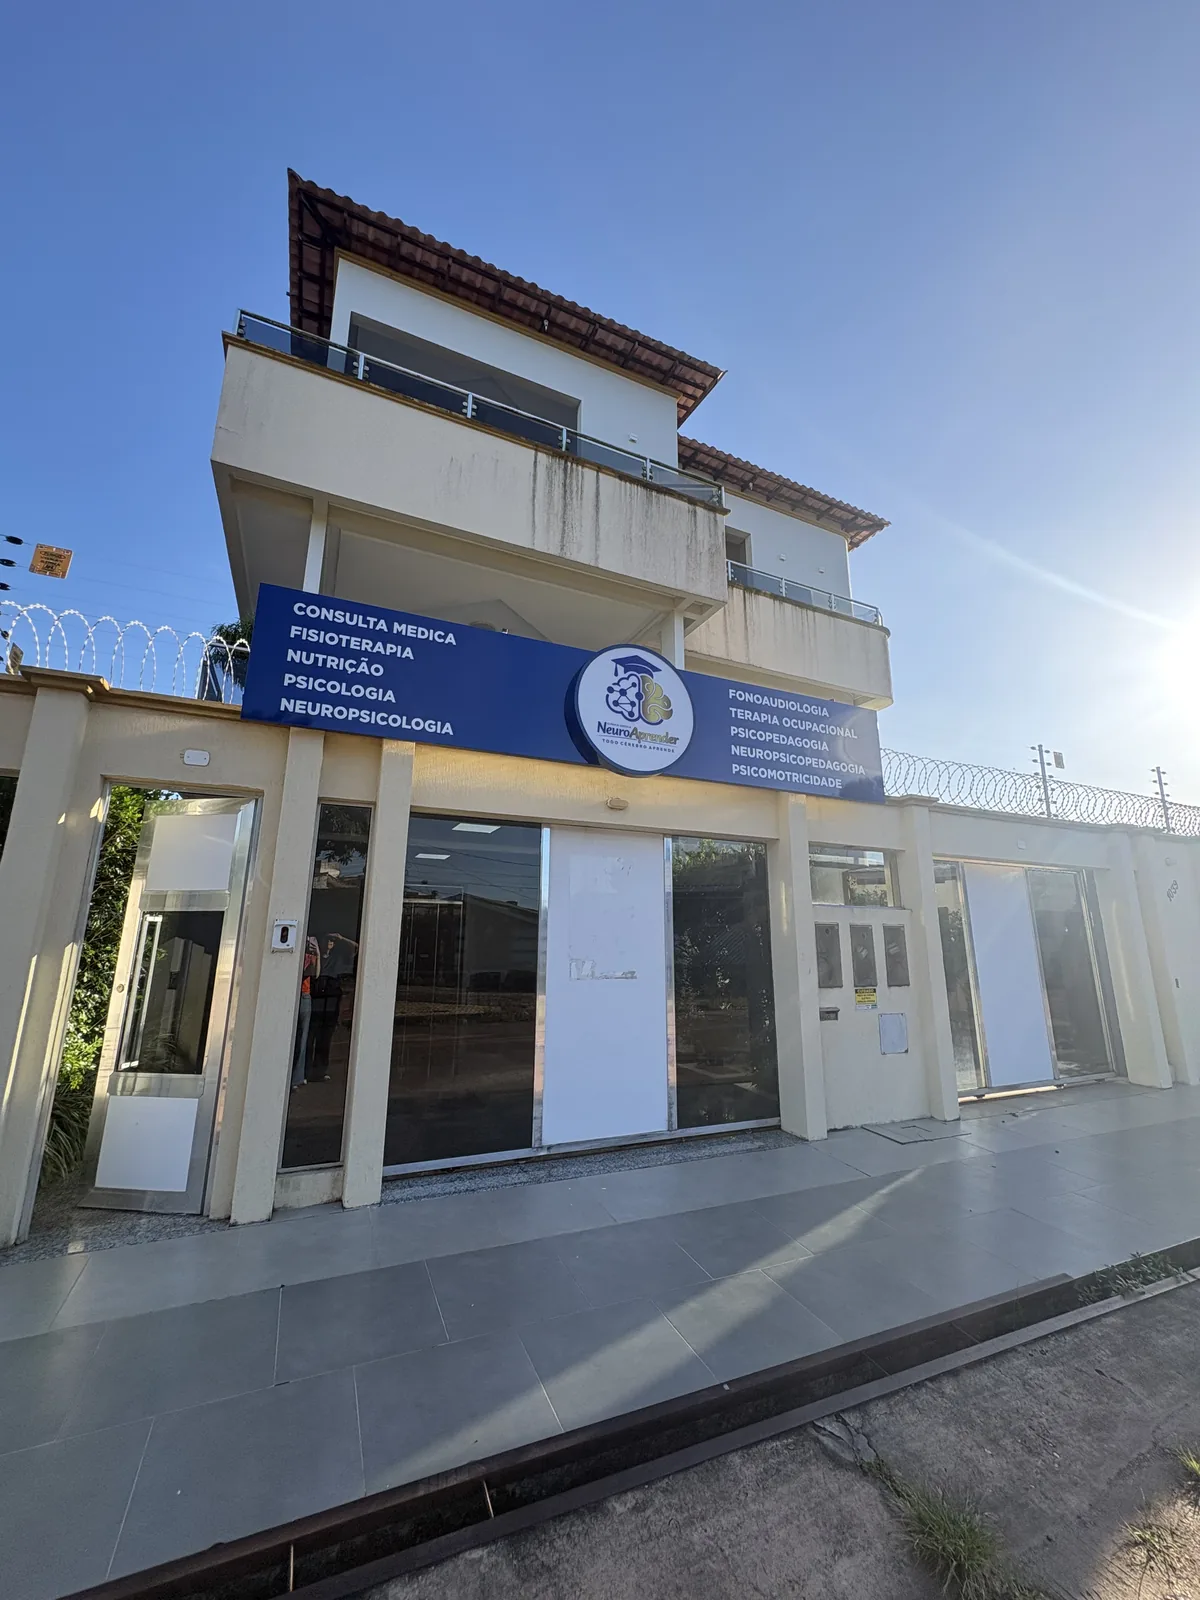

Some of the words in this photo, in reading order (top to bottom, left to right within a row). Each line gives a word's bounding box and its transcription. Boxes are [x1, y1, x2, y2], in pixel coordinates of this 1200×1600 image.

[293, 602, 388, 633] CONSULTA
[392, 621, 457, 645] MEDICA
[290, 625, 414, 660] FISIOTERAPIA
[286, 648, 384, 677] NUTRIÇÃO
[283, 673, 396, 703] PSICOLOGIA
[728, 688, 830, 717] FONOAUDIOLOGIA
[280, 697, 454, 735] NEUROPSICOLOGIA
[729, 707, 780, 726] TERAPIA
[782, 717, 858, 739] OCUPACIONAL
[730, 726, 829, 751] PSICOPEDAGOGIA
[731, 744, 866, 775] NEUROPSICOPEDAGOGIA
[732, 763, 843, 789] PSICOMOTRICIDADE
